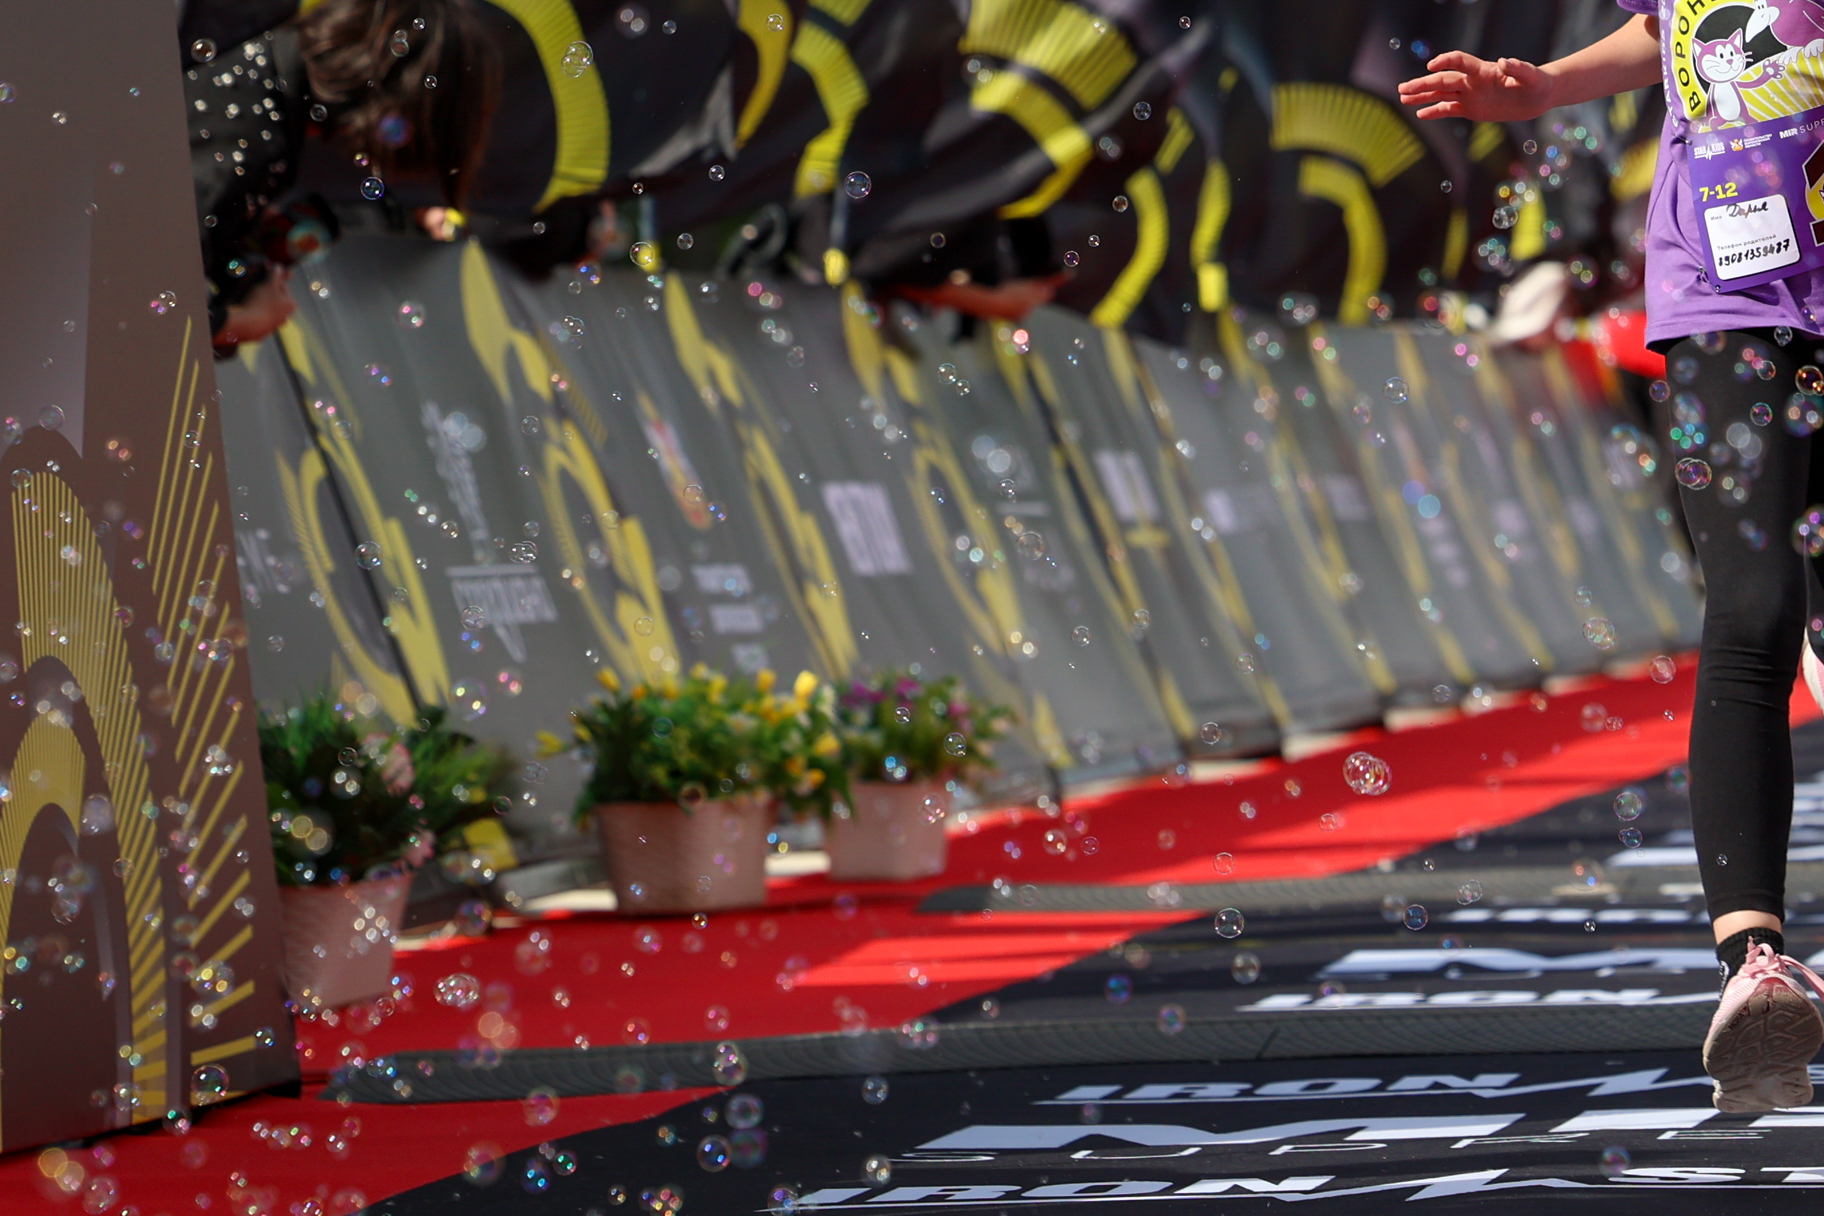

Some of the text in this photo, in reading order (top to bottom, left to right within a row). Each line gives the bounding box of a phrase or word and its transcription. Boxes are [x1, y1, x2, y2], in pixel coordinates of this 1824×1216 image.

[1699, 181, 1739, 202] 7-12
[1717, 233, 1777, 251] Телефон родителей
[1055, 1072, 1522, 1101] IRON
[798, 1175, 1337, 1205] IRON
